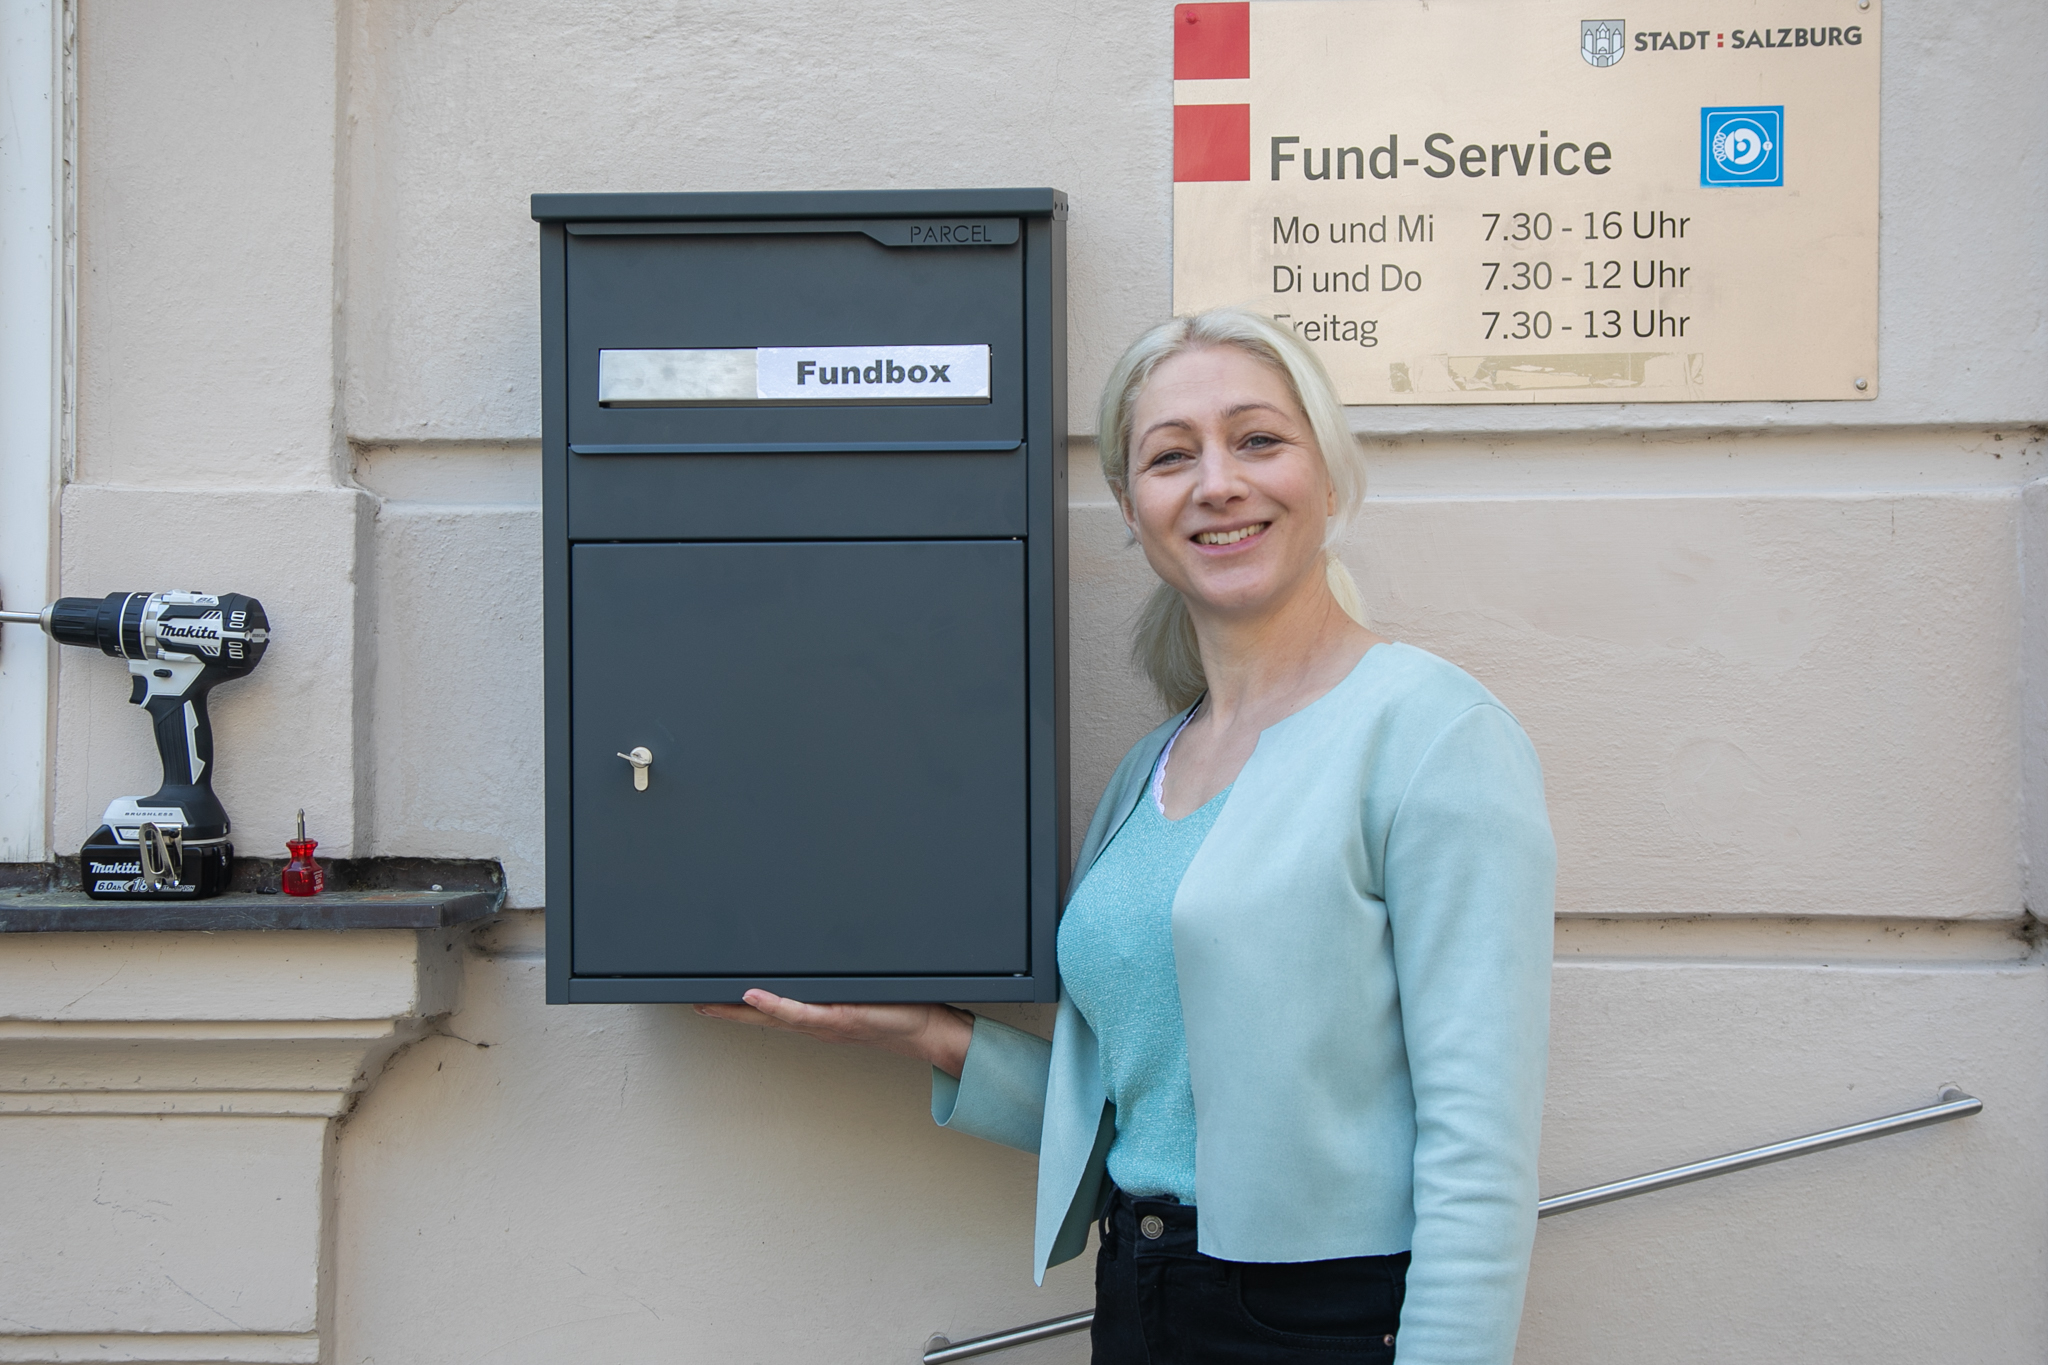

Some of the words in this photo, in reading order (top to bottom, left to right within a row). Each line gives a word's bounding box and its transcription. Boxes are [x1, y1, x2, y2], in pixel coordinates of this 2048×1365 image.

[1635, 30, 1711, 52] STADT
[1731, 26, 1862, 50] SALZBURG
[1271, 131, 1612, 181] Fund-Service
[911, 225, 992, 243] PARCEL
[1273, 216, 1320, 244] Mo
[1330, 215, 1386, 243] und
[1399, 214, 1434, 242] Mi
[1482, 212, 1553, 242] 7.30
[1584, 211, 1622, 240] 16
[1633, 210, 1691, 240] Uhr
[1273, 264, 1302, 293] Di
[1313, 264, 1369, 293] und
[1381, 264, 1422, 292] Do
[1481, 261, 1552, 290] 7.30
[1584, 260, 1622, 289] 12
[1633, 259, 1691, 289] Uhr
[1481, 310, 1552, 340] 7.30
[1584, 309, 1622, 339] 13
[1633, 309, 1691, 338] Uhr
[797, 360, 951, 386] Fundbox
[159, 623, 219, 640] Makita
[89, 862, 142, 874] Makita
